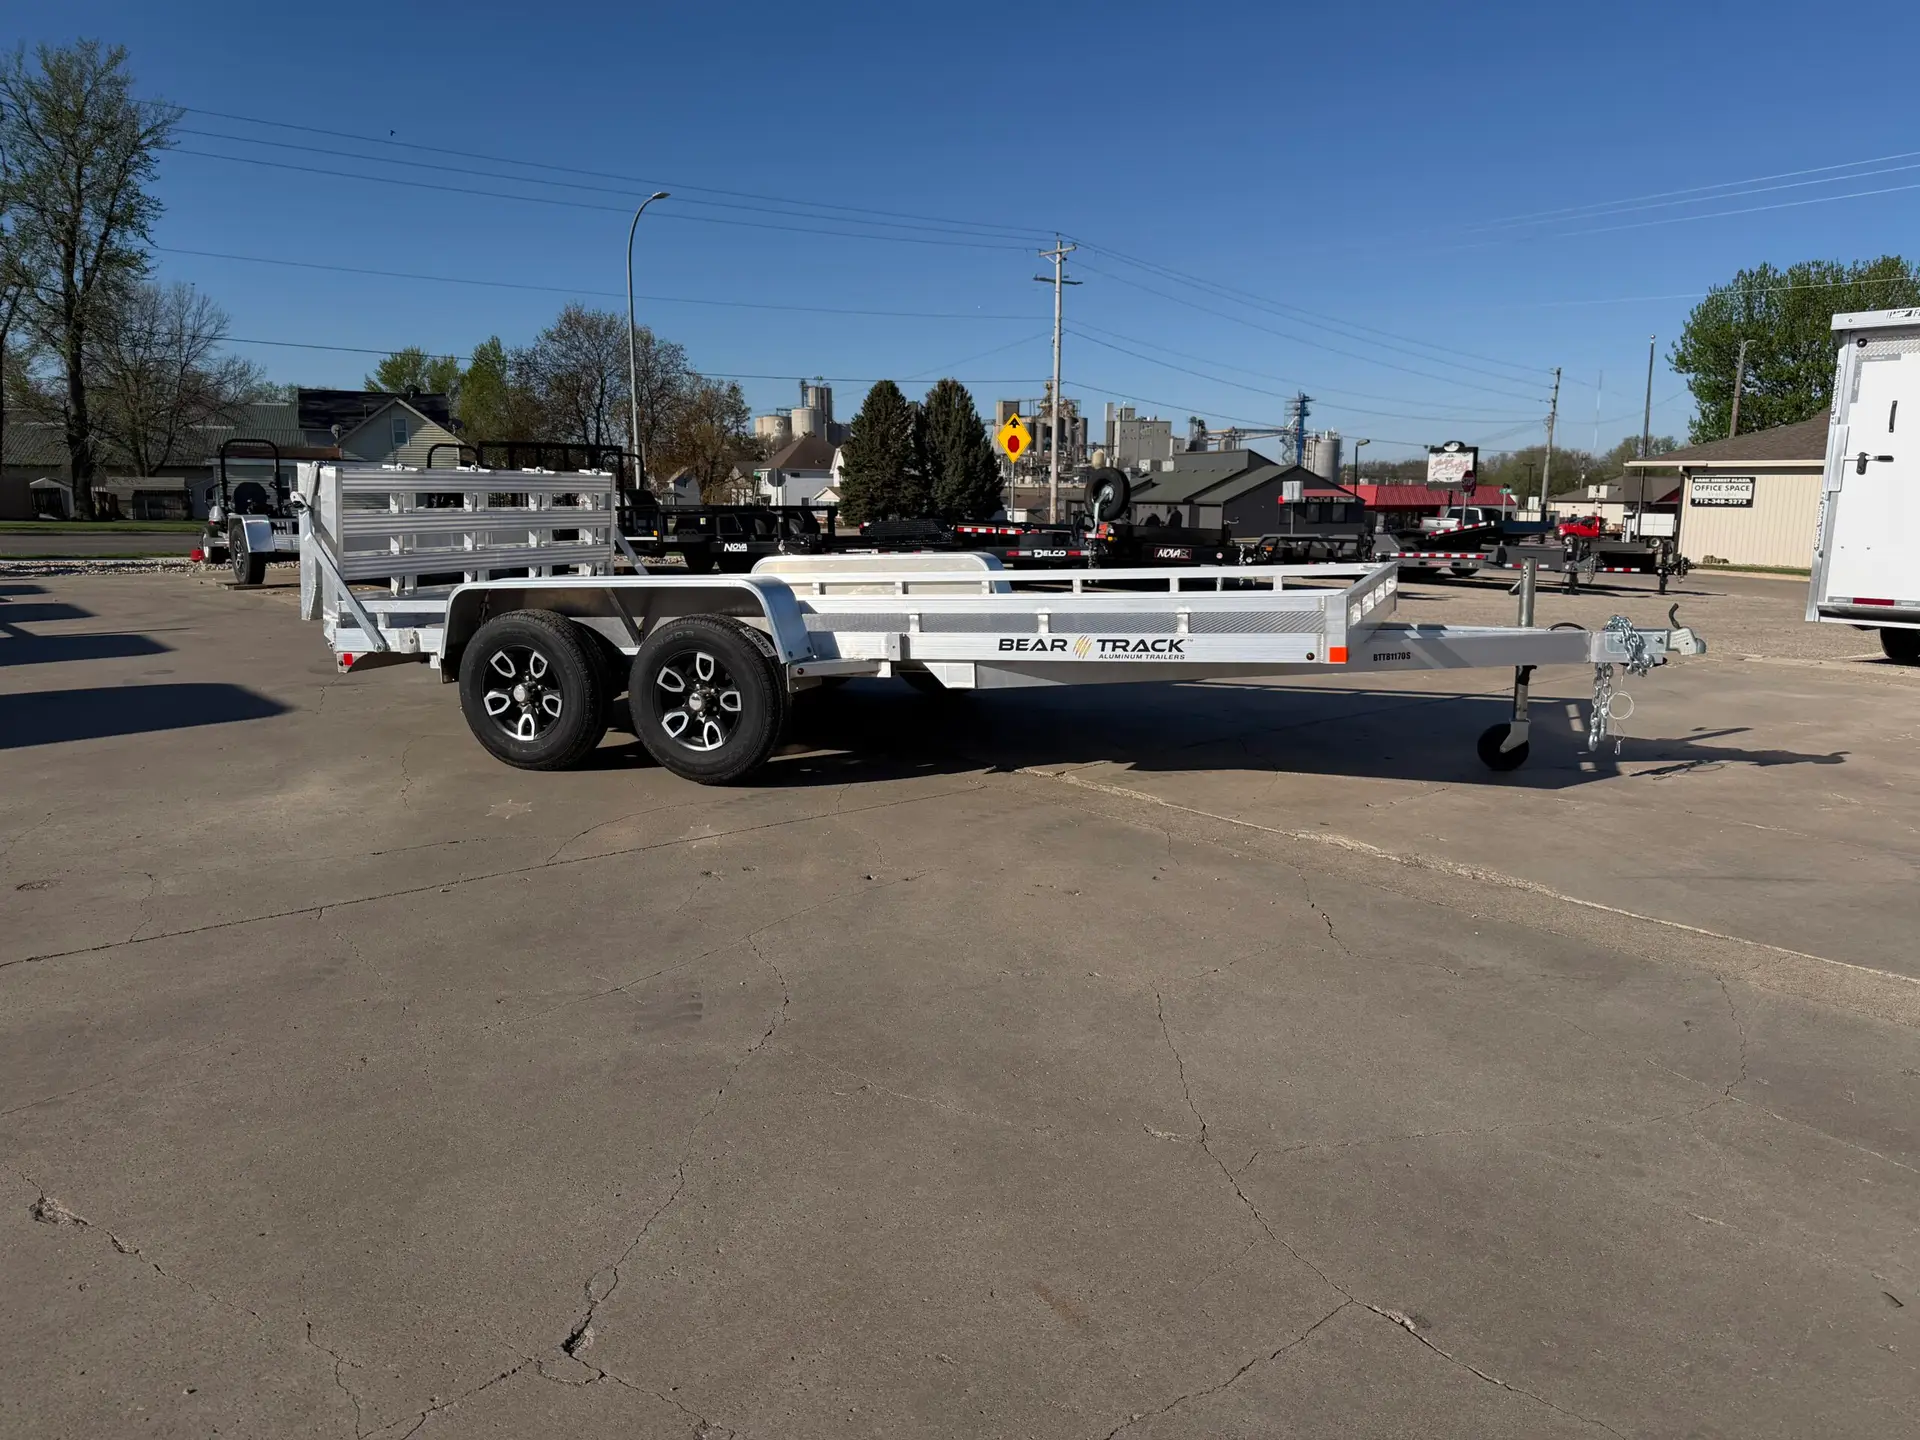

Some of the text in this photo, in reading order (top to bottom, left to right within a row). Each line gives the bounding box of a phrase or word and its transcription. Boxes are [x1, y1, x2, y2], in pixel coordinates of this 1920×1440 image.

[1462, 477, 1475, 486] STOP
[1694, 484, 1722, 492] OFFICE
[723, 543, 748, 552] NOVA
[1033, 549, 1067, 558] DELCO
[1156, 548, 1181, 559] NOVA
[998, 638, 1068, 652] BEAR
[1096, 639, 1186, 653] TRACK
